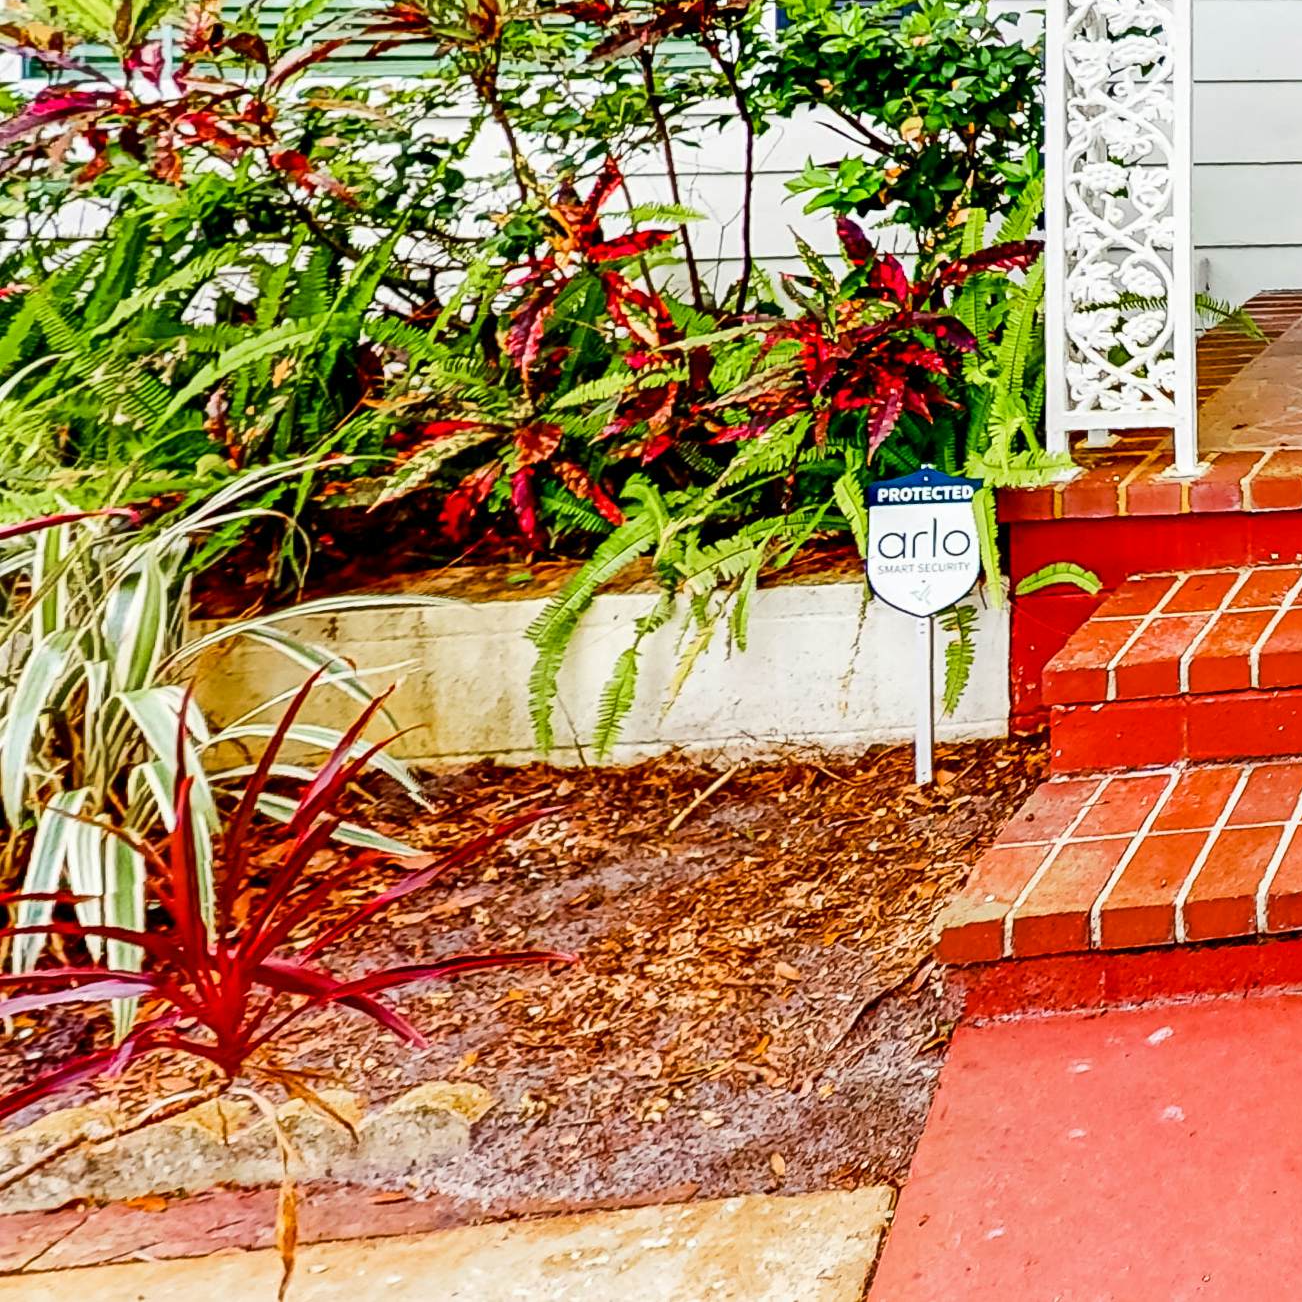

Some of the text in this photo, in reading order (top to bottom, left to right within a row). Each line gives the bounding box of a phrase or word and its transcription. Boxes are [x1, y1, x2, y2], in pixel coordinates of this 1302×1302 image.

[877, 485, 974, 502] PROTECTED
[878, 518, 970, 559] arlo
[878, 562, 970, 575] SMART SECURITY
